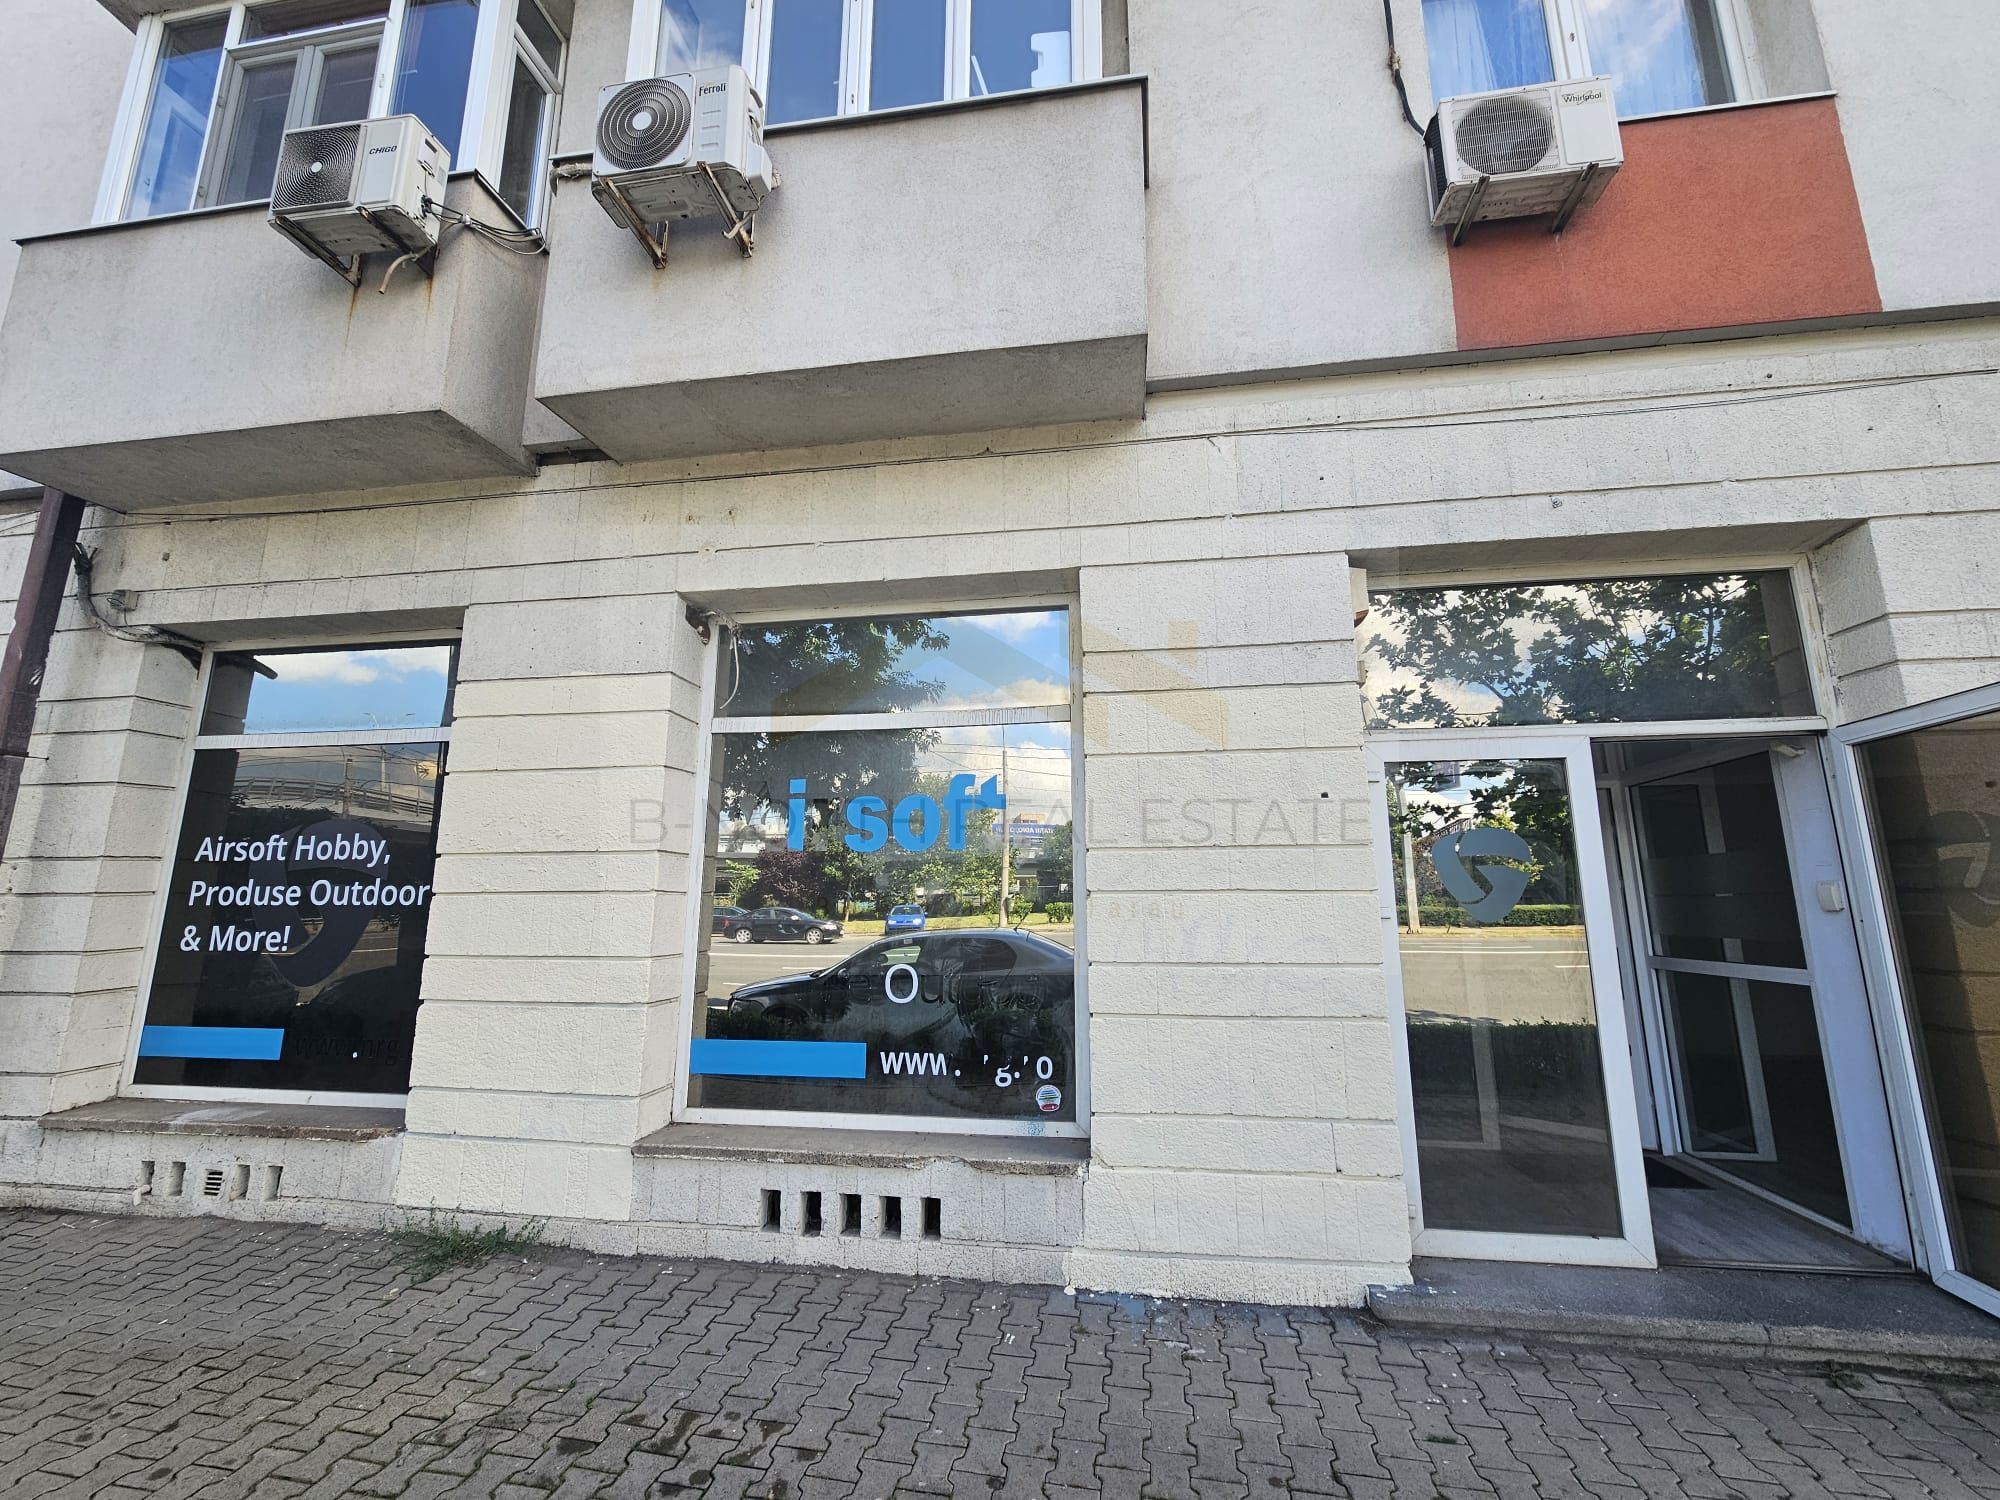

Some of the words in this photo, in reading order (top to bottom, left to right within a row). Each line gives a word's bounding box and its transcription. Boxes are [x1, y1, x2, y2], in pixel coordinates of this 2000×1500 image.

[699, 82, 727, 96] Ferroli
[1562, 90, 1602, 104] Whirlpool
[368, 145, 398, 155] CHIGO
[194, 834, 288, 862] Airsoft
[294, 832, 392, 868] Hobby,
[188, 878, 301, 907] Produse
[310, 878, 431, 907] Outdoor
[180, 925, 202, 953] &
[208, 924, 292, 953] More!
